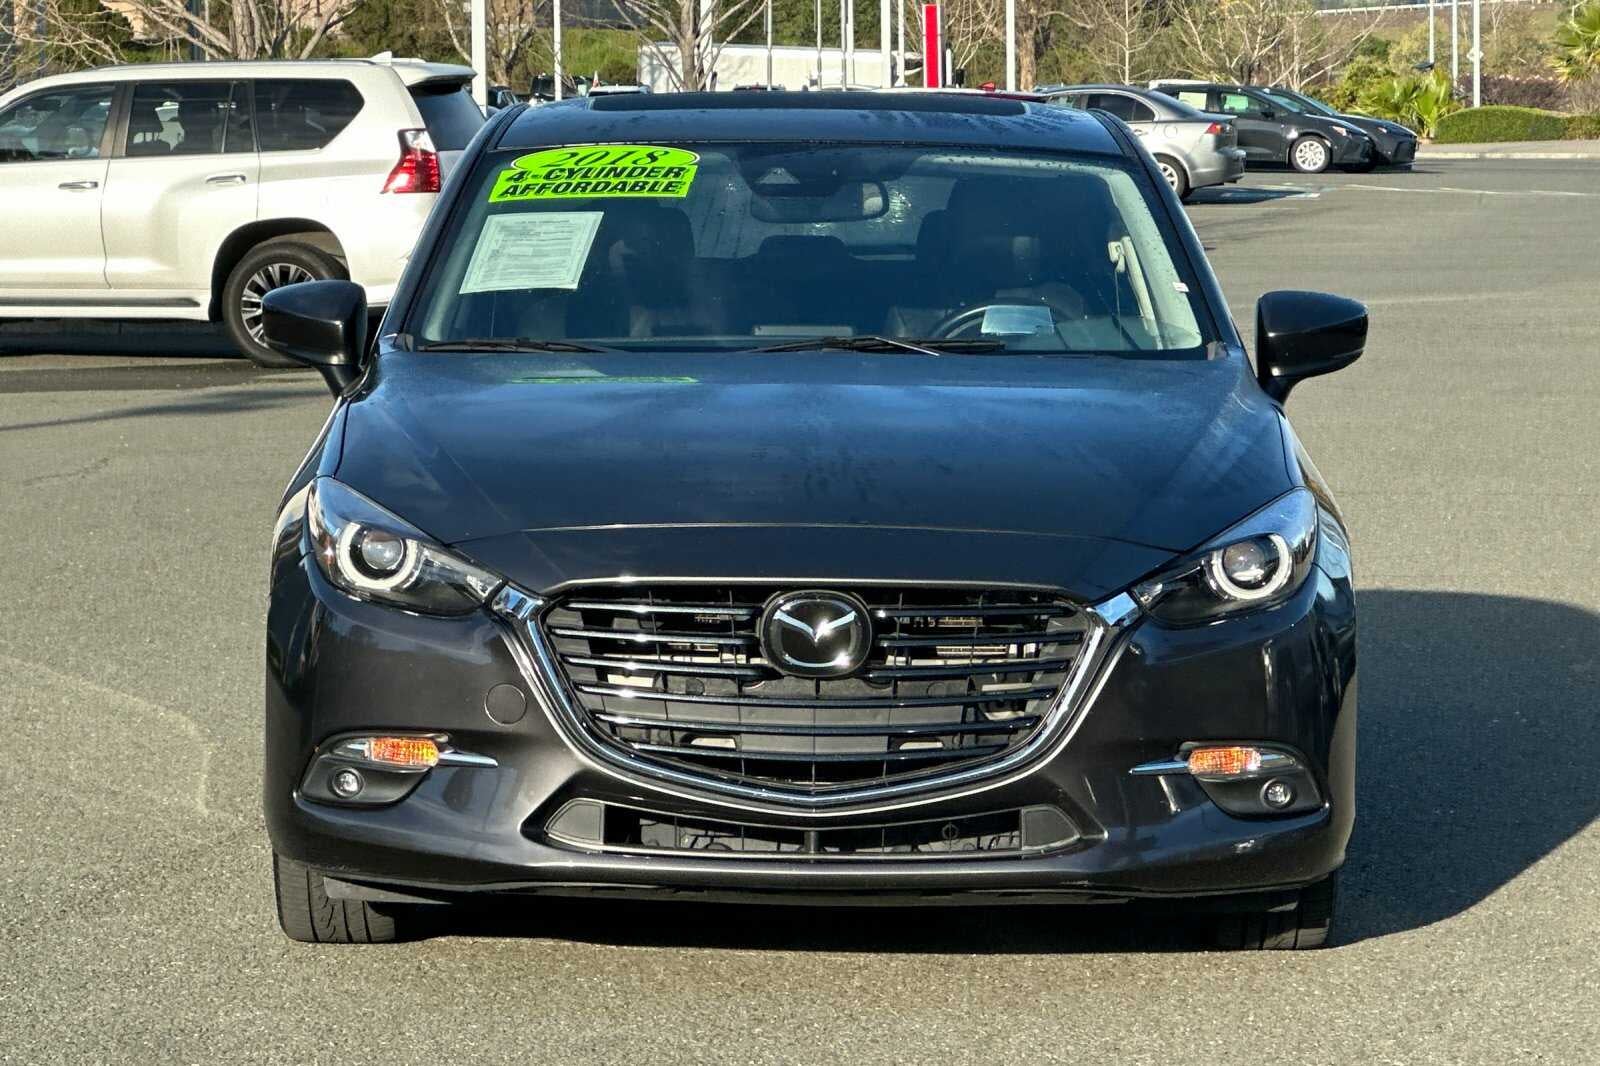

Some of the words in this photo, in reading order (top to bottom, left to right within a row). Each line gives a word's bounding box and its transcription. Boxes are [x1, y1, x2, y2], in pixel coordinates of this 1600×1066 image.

[541, 150, 671, 168] 2018
[506, 166, 685, 182] 4-CYLINDER
[501, 180, 682, 197] AFFORDABLE
